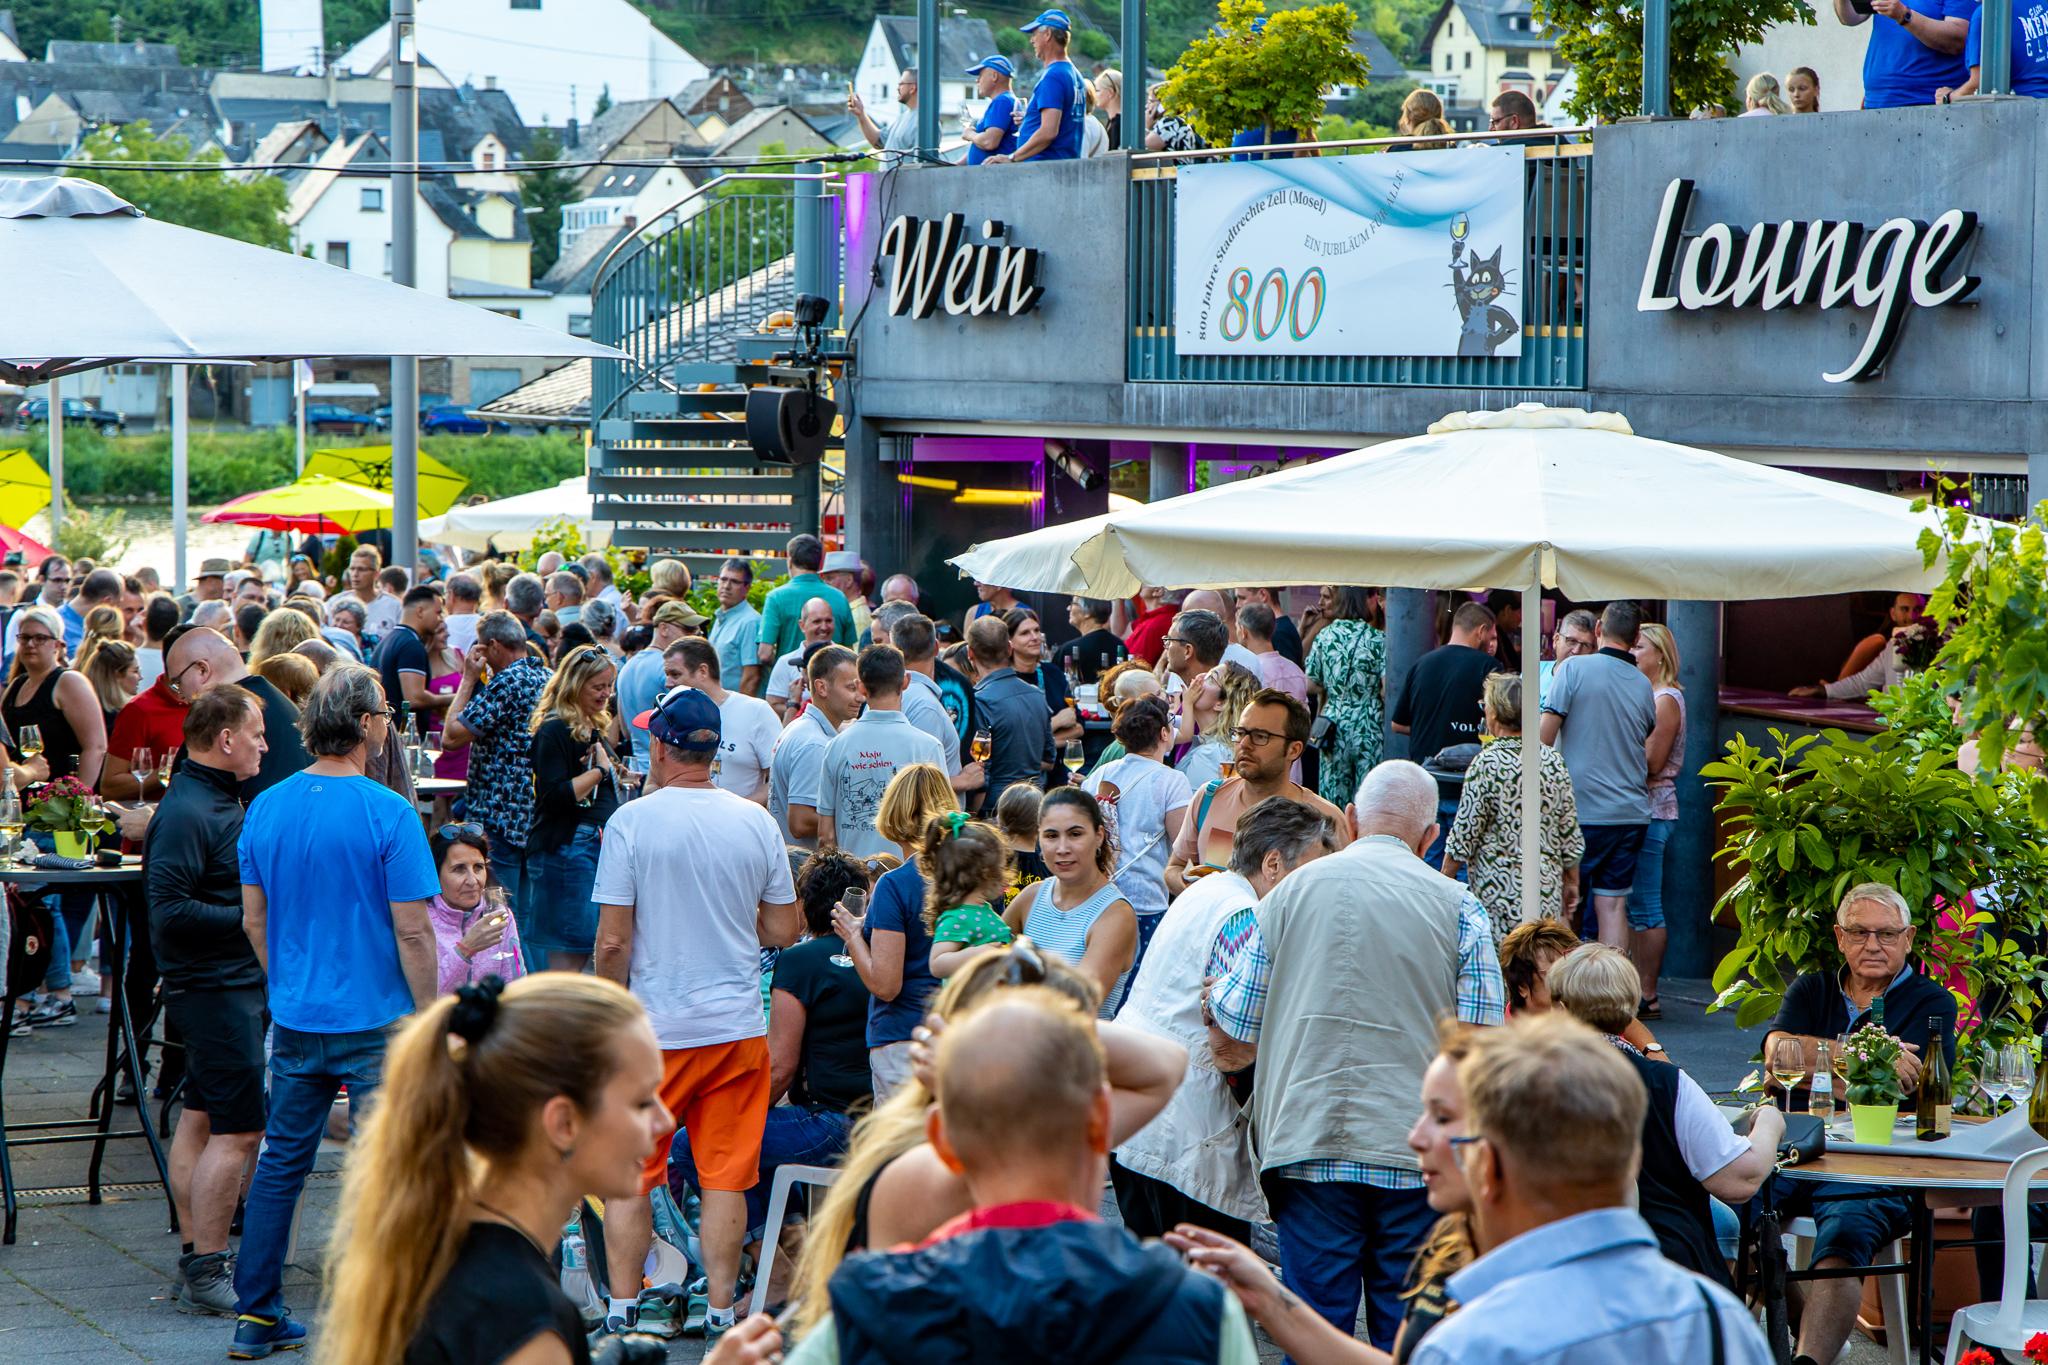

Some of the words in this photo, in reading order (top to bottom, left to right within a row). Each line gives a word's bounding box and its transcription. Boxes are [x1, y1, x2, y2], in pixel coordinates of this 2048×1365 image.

[1266, 189, 1287, 208] Zell
[1288, 188, 1327, 216] (Mosel)
[1303, 233, 1321, 253] EIN
[1320, 227, 1371, 257] JUBILÄUM
[1369, 206, 1389, 235] FÜR
[1386, 169, 1405, 207] ALLE
[1215, 200, 1266, 263] Stadtrechte
[880, 211, 1045, 321] Wein
[1202, 263, 1220, 311] Jahre
[1636, 177, 1981, 384] Lounge
[1199, 310, 1209, 341] 800
[1219, 265, 1327, 342] 800
